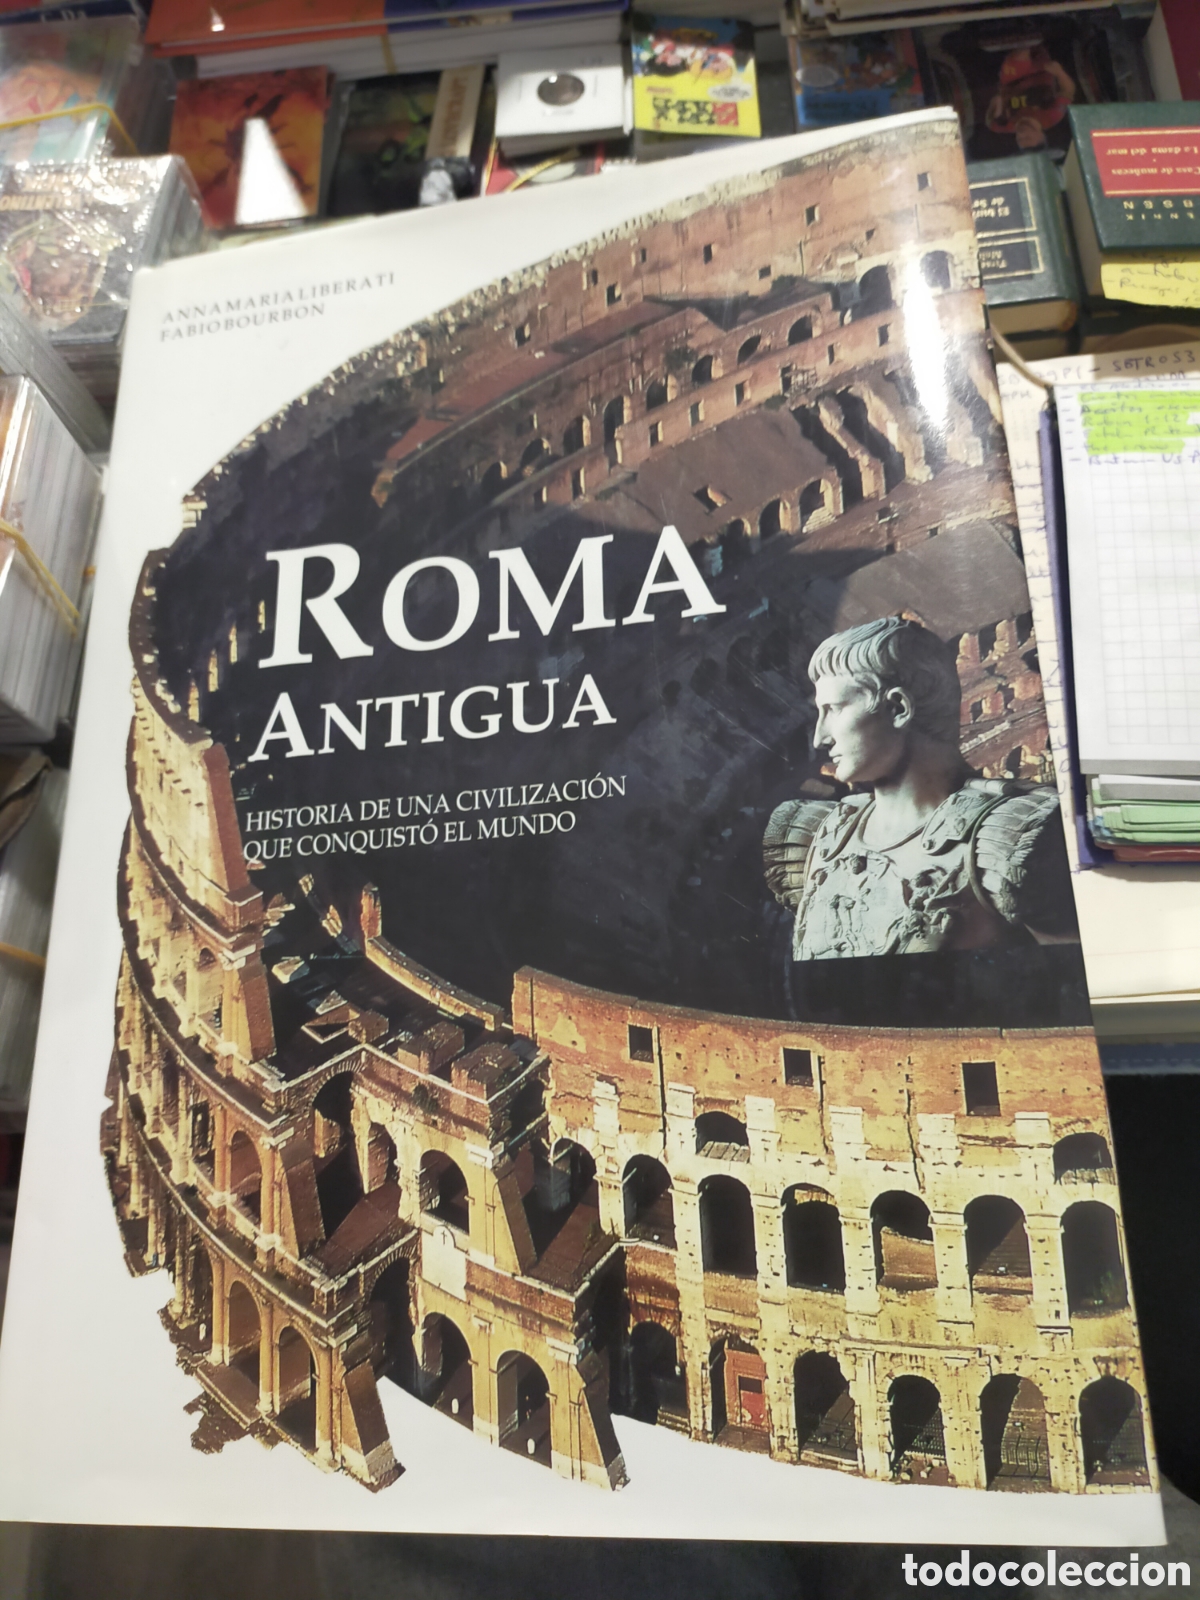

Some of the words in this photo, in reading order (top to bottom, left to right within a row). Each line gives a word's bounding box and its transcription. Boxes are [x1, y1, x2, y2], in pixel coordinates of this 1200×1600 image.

[258, 525, 727, 669] ROMA
[247, 673, 617, 763] ANTIGUA
[243, 838, 294, 865] QUE
[296, 821, 439, 857] CONQUISTÓ
[444, 820, 472, 844] EL
[478, 810, 577, 841] MUNDO
[245, 802, 354, 832] HISTORIA
[360, 799, 392, 822] DE
[396, 793, 451, 817] UNA
[455, 772, 628, 812] CIVILIZACIÓN
